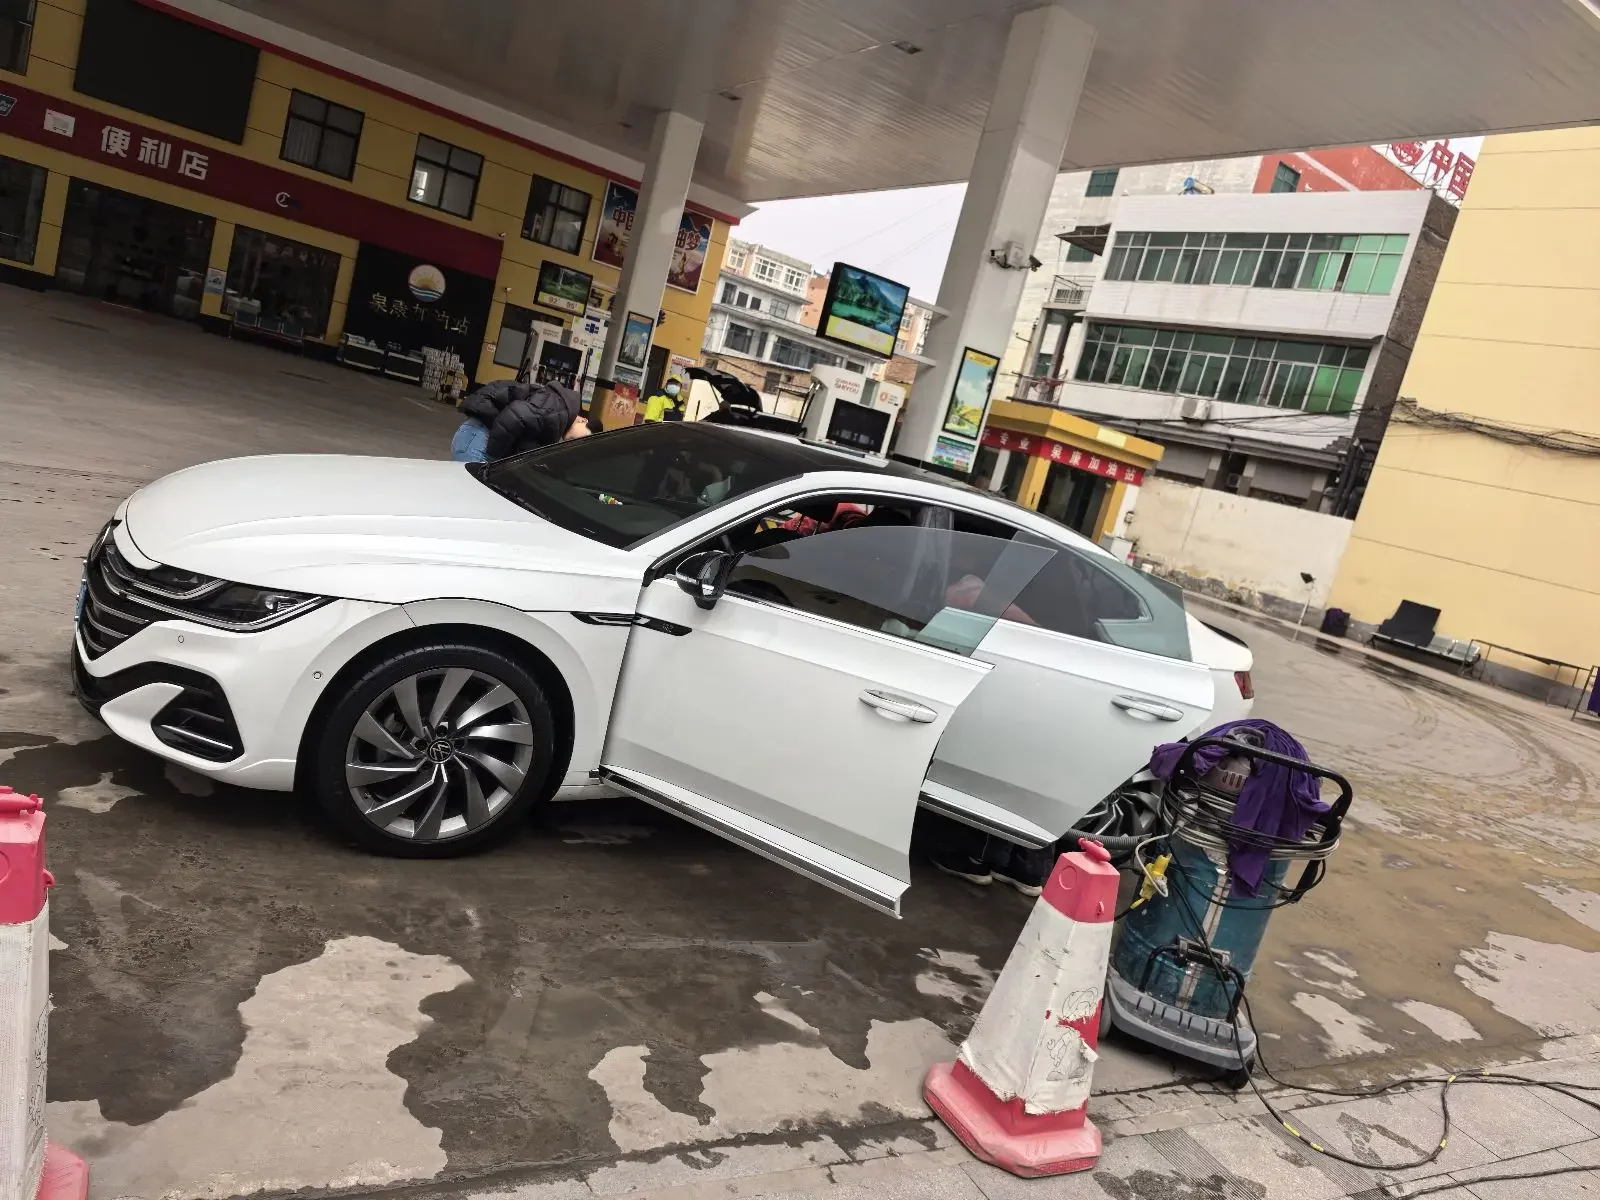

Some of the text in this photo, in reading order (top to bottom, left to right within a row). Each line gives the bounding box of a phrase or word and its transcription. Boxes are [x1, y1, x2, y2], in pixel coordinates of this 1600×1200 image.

[101, 125, 209, 182] 便利店
[1430, 138, 1476, 200] 中国
